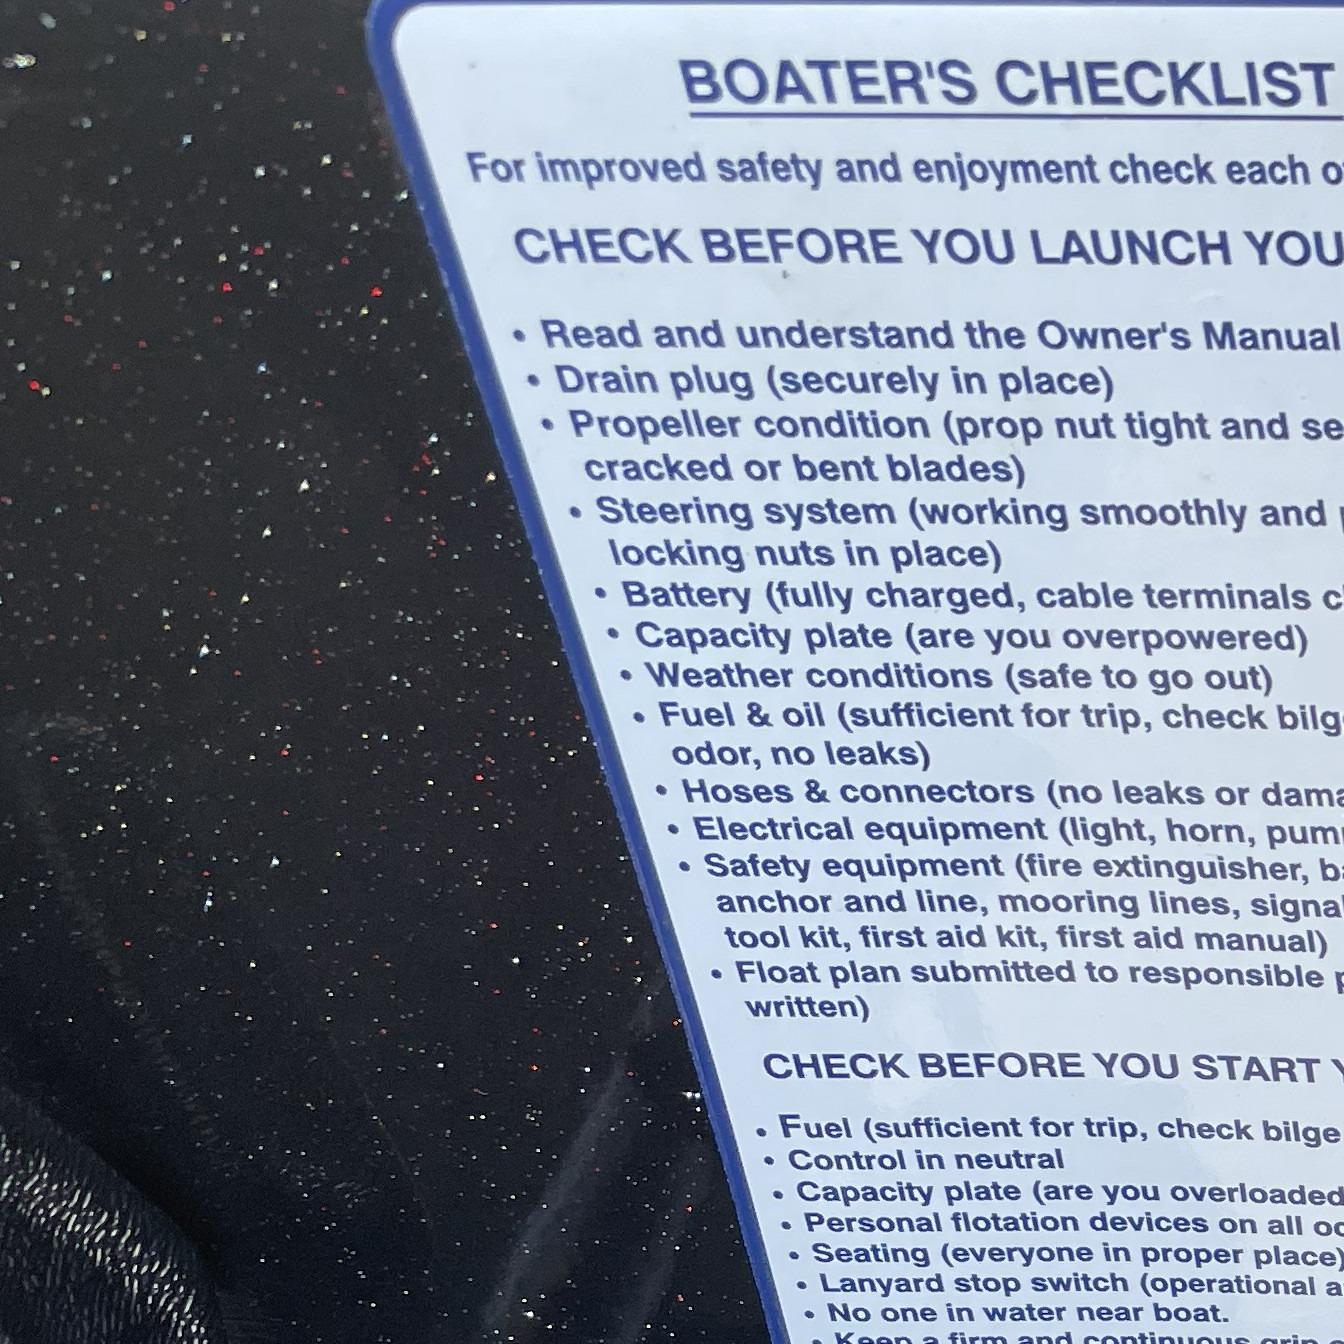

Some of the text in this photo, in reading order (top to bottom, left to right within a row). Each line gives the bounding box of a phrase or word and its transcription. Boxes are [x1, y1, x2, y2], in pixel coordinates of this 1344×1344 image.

[679, 58, 1335, 107] BOATER'S CHECKLIST
[466, 152, 524, 182] For
[535, 151, 706, 190] improved
[717, 151, 822, 190] safety
[836, 152, 902, 182] and
[913, 152, 1100, 191] enjoyment
[1109, 153, 1215, 184] check
[1226, 154, 1310, 185] each
[514, 228, 691, 264] CHECK
[700, 228, 902, 264] BEFORE
[911, 228, 1014, 264] YOU
[1030, 229, 1232, 265] LAUNCH
[540, 319, 1340, 351] Read and understand the Owner's Manual
[555, 365, 1113, 402] Drain plug (securely in place)
[596, 496, 754, 531] Steering
[764, 498, 896, 531] system
[909, 497, 1069, 532] (working
[1080, 498, 1247, 533] smoothly
[1260, 499, 1327, 527] and
[659, 702, 735, 727] Fuel
[747, 702, 773, 727] &
[783, 702, 825, 727] oil
[838, 702, 1014, 733] (sufficient
[1021, 702, 1070, 728] for
[1080, 702, 1151, 734] trip,
[1163, 703, 1268, 729] check
[672, 741, 930, 772] odor, no leaks)
[704, 853, 810, 883] Safety
[823, 853, 1004, 883] equipment
[1015, 853, 1082, 882] (fire
[1093, 854, 1309, 885] extinguisher,
[763, 1053, 910, 1079] CHECK
[918, 1052, 1085, 1078] BEFORE
[1093, 1053, 1179, 1079] YOU
[1192, 1054, 1321, 1083] START
[789, 1148, 1064, 1170] Control in neutral
[804, 1212, 942, 1232] Personal
[951, 1211, 1079, 1232] flotation
[1089, 1211, 1209, 1233] devices
[1219, 1218, 1257, 1234] on
[1268, 1215, 1303, 1235] all
[827, 1303, 1229, 1322] No one in water near boat.
